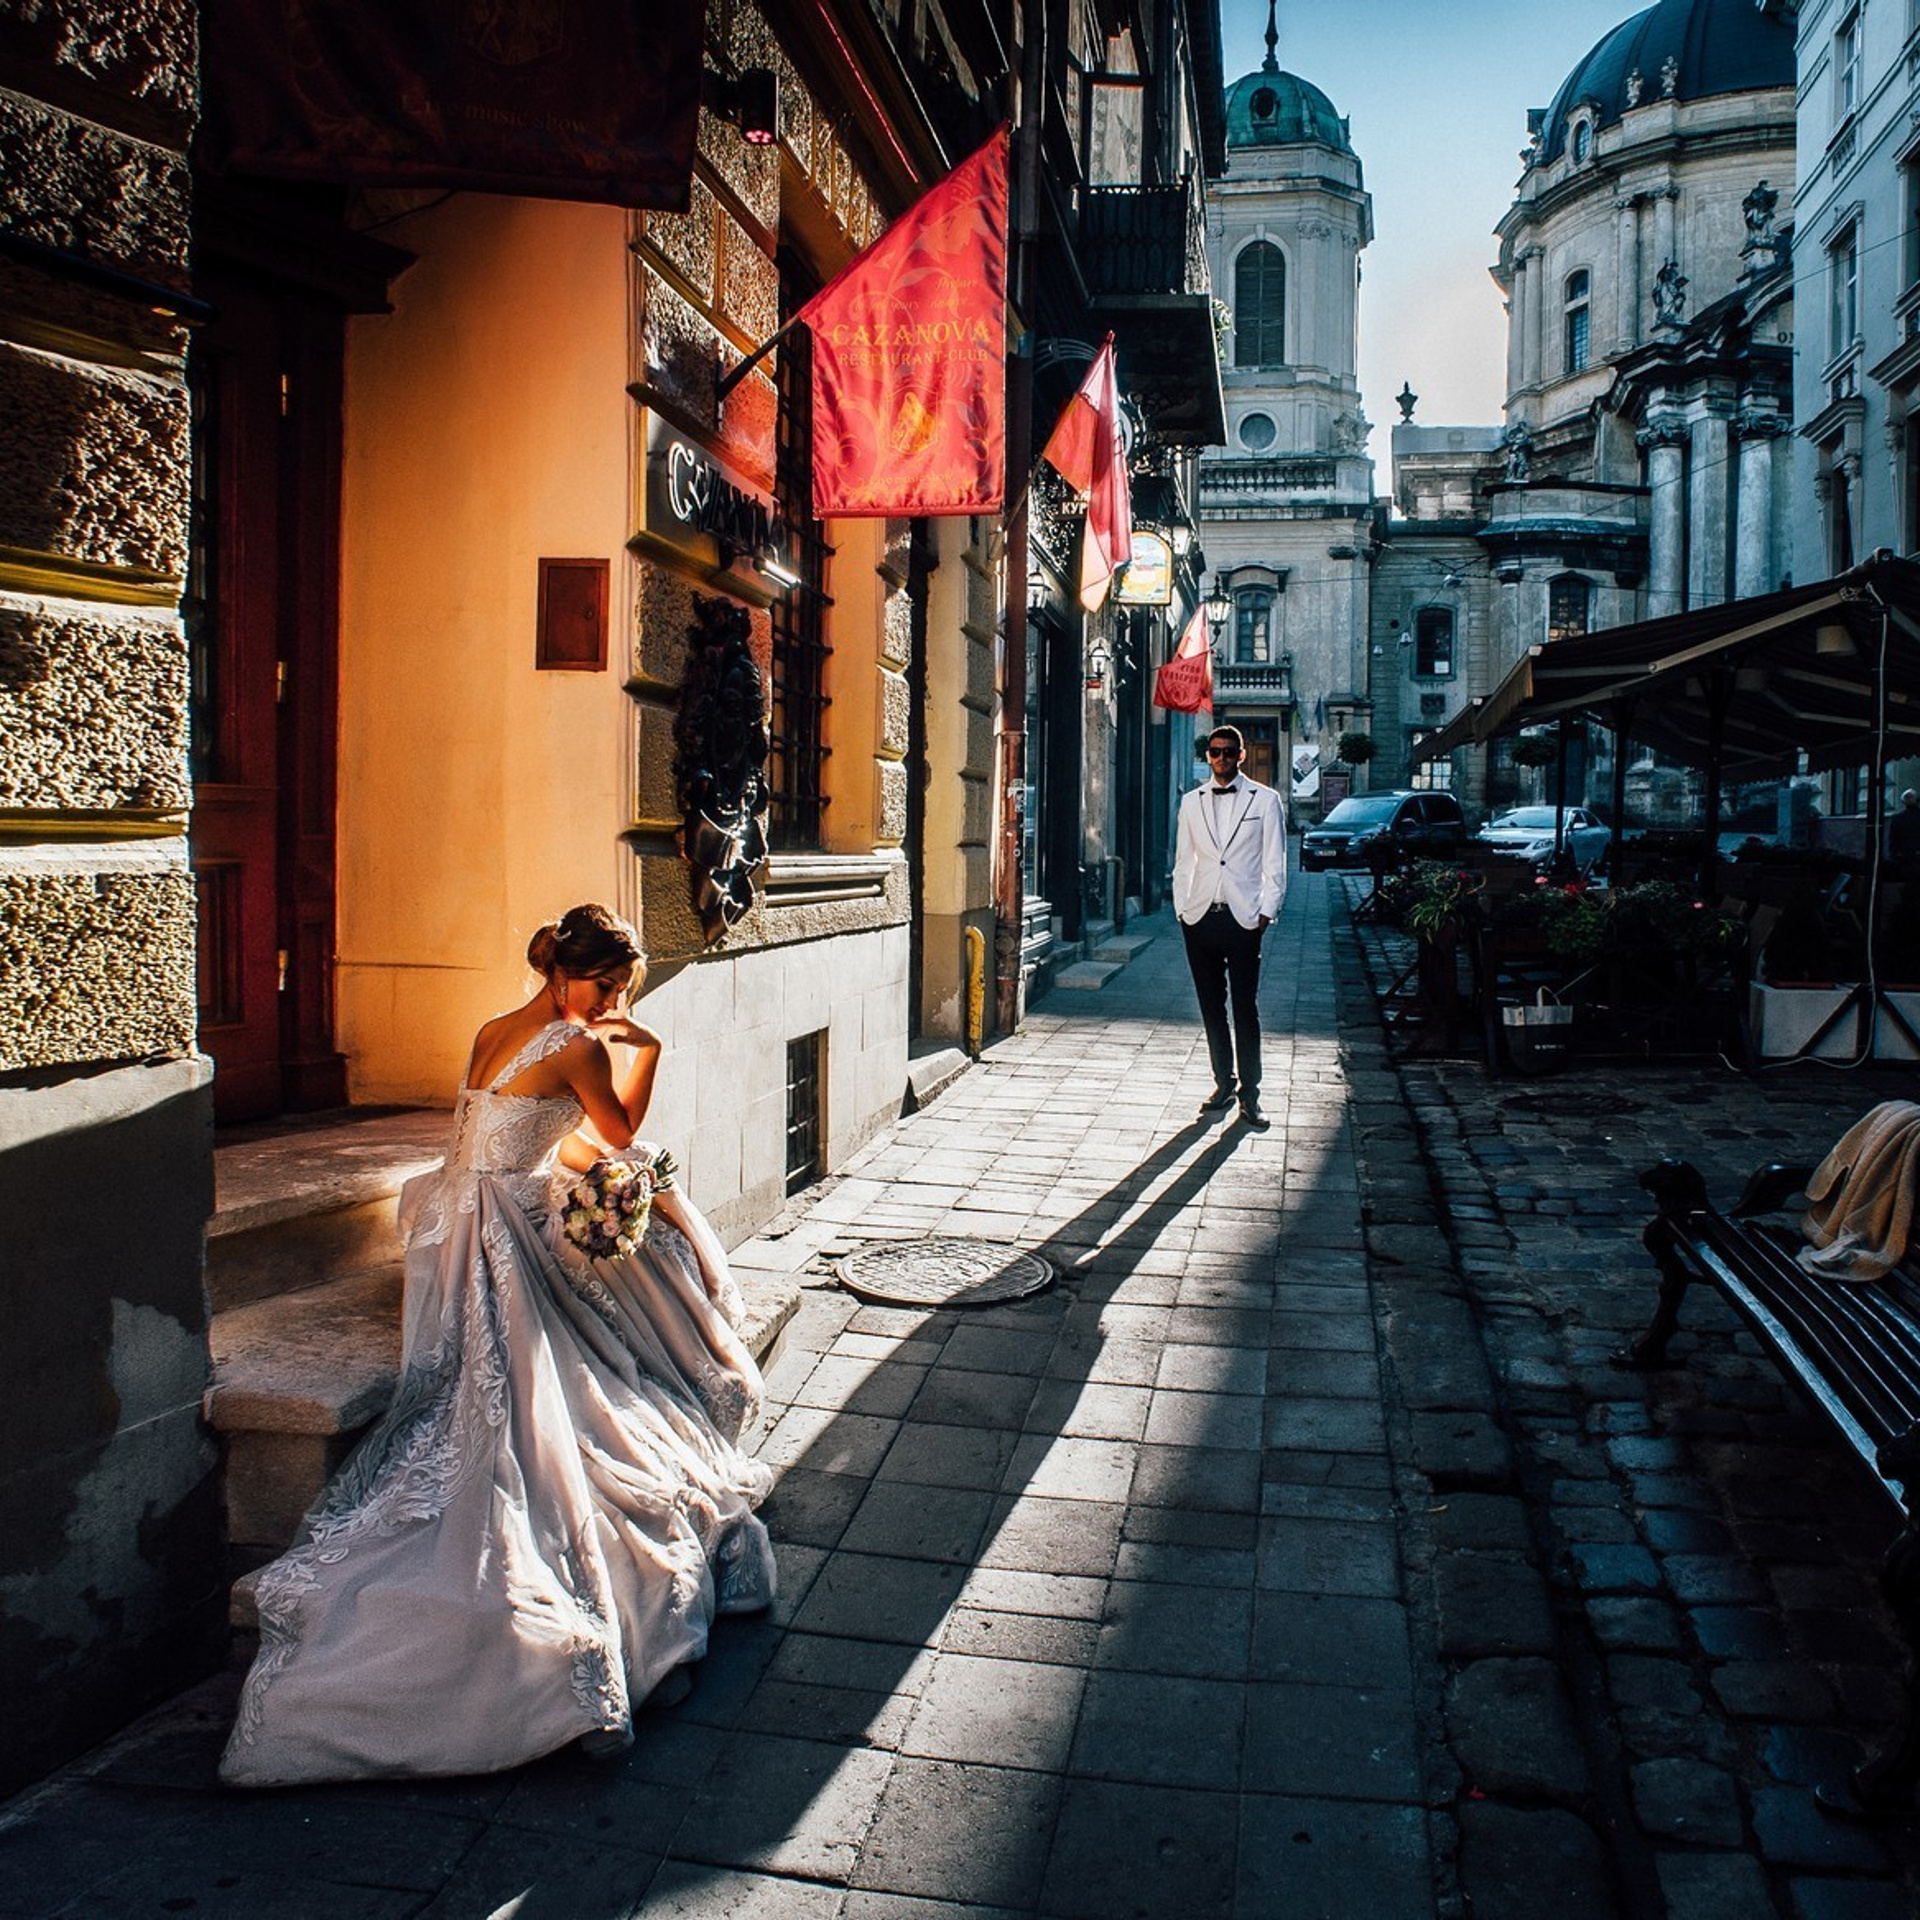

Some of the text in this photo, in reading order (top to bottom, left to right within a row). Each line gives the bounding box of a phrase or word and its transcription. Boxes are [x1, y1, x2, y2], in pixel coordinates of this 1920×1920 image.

[464, 103, 528, 126] music
[533, 111, 591, 133] show
[832, 317, 991, 347] CAZANOVA
